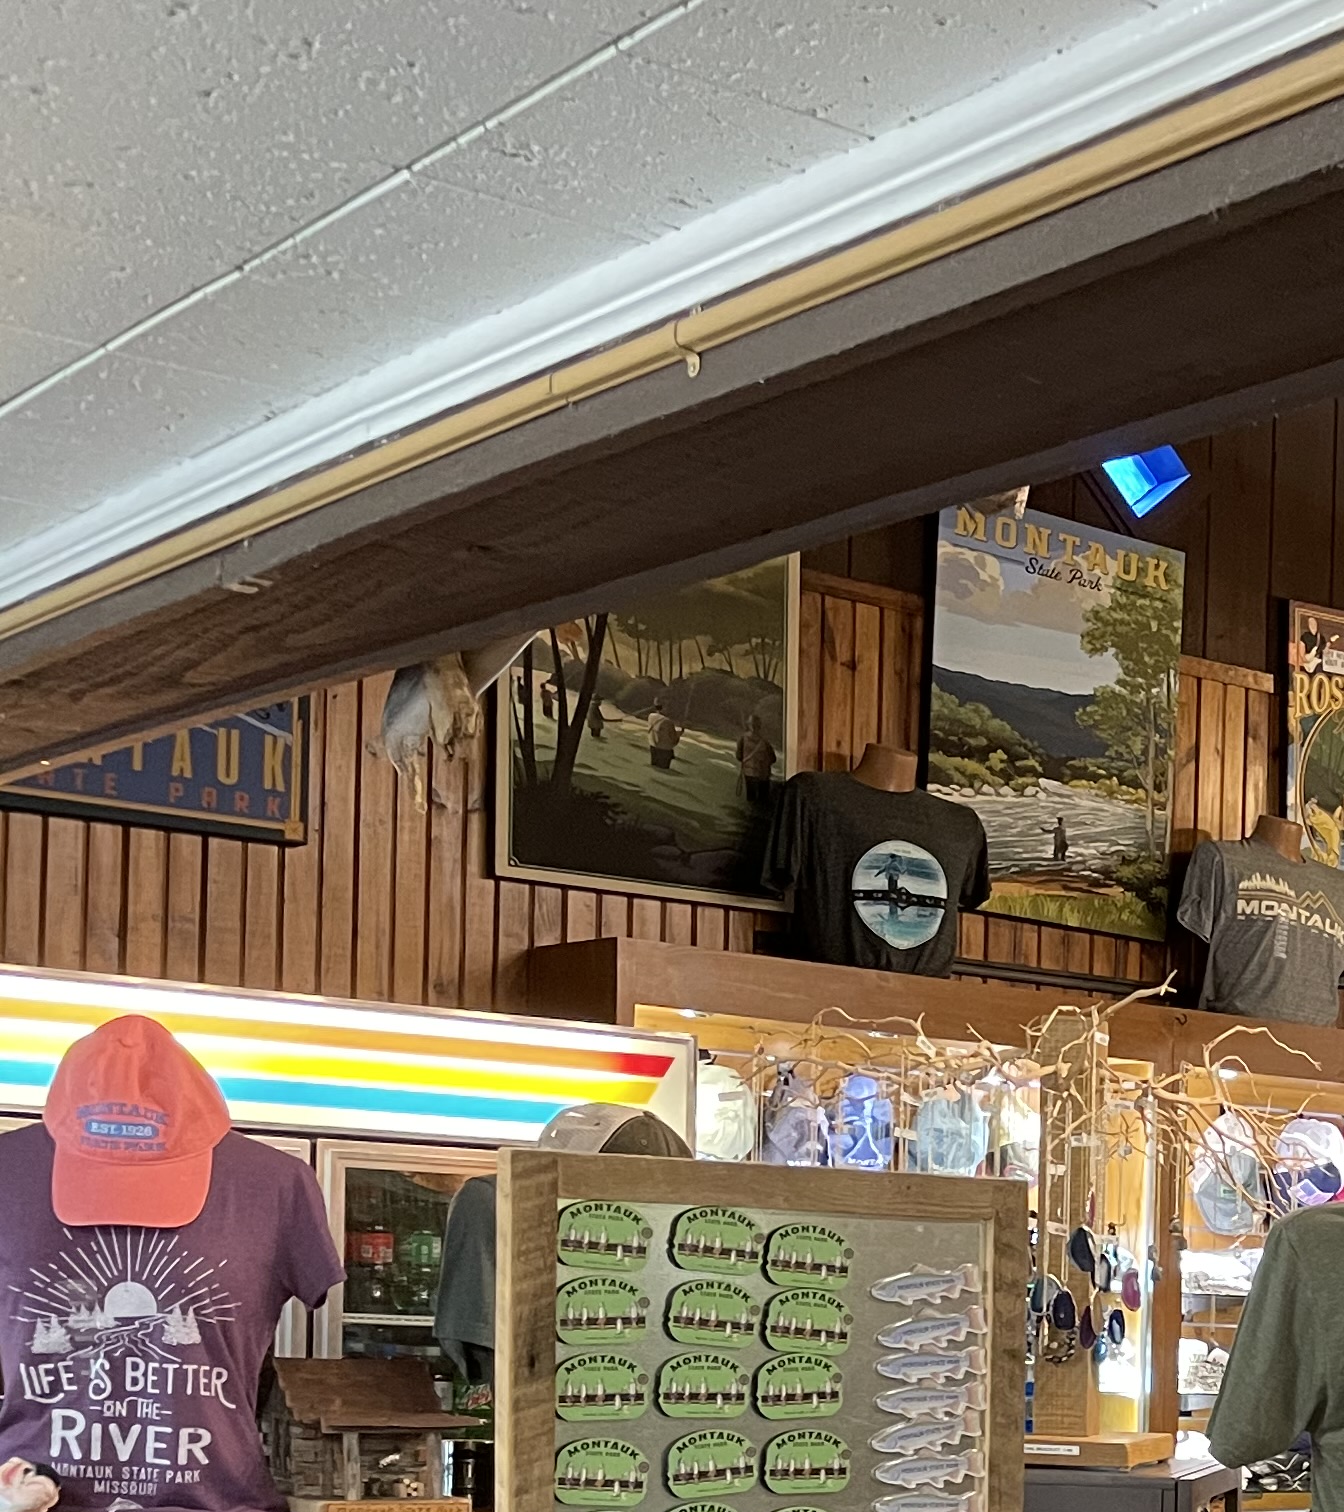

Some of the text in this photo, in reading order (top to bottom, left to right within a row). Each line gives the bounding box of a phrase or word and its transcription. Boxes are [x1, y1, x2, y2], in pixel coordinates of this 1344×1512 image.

[954, 506, 1169, 590] MONTAUK
[1025, 557, 1103, 592] State Park
[167, 782, 283, 820] PARK
[121, 1124, 153, 1137] 1926
[570, 1203, 643, 1225] MONTAUK
[686, 1207, 755, 1231] MONTAUK
[779, 1224, 845, 1246] MONTAUK
[565, 1277, 640, 1298] MONTAUK
[682, 1281, 751, 1303] MONTAUK
[778, 1291, 845, 1312] MONTAUK
[564, 1354, 637, 1374] MONTAUK
[669, 1354, 739, 1374] MONTAUK
[765, 1355, 833, 1375] MONTAUK
[19, 1356, 237, 1409] LIFE IS BETTER
[102, 1396, 162, 1421] ON THE
[49, 1408, 213, 1466] RIVER
[676, 1431, 745, 1454] MONTAUK
[775, 1431, 842, 1449] MONTAUK
[567, 1440, 641, 1460] MONTAUK
[51, 1460, 201, 1484] MONTAUK STATE PARK
[93, 1479, 158, 1496] MISSOURI
